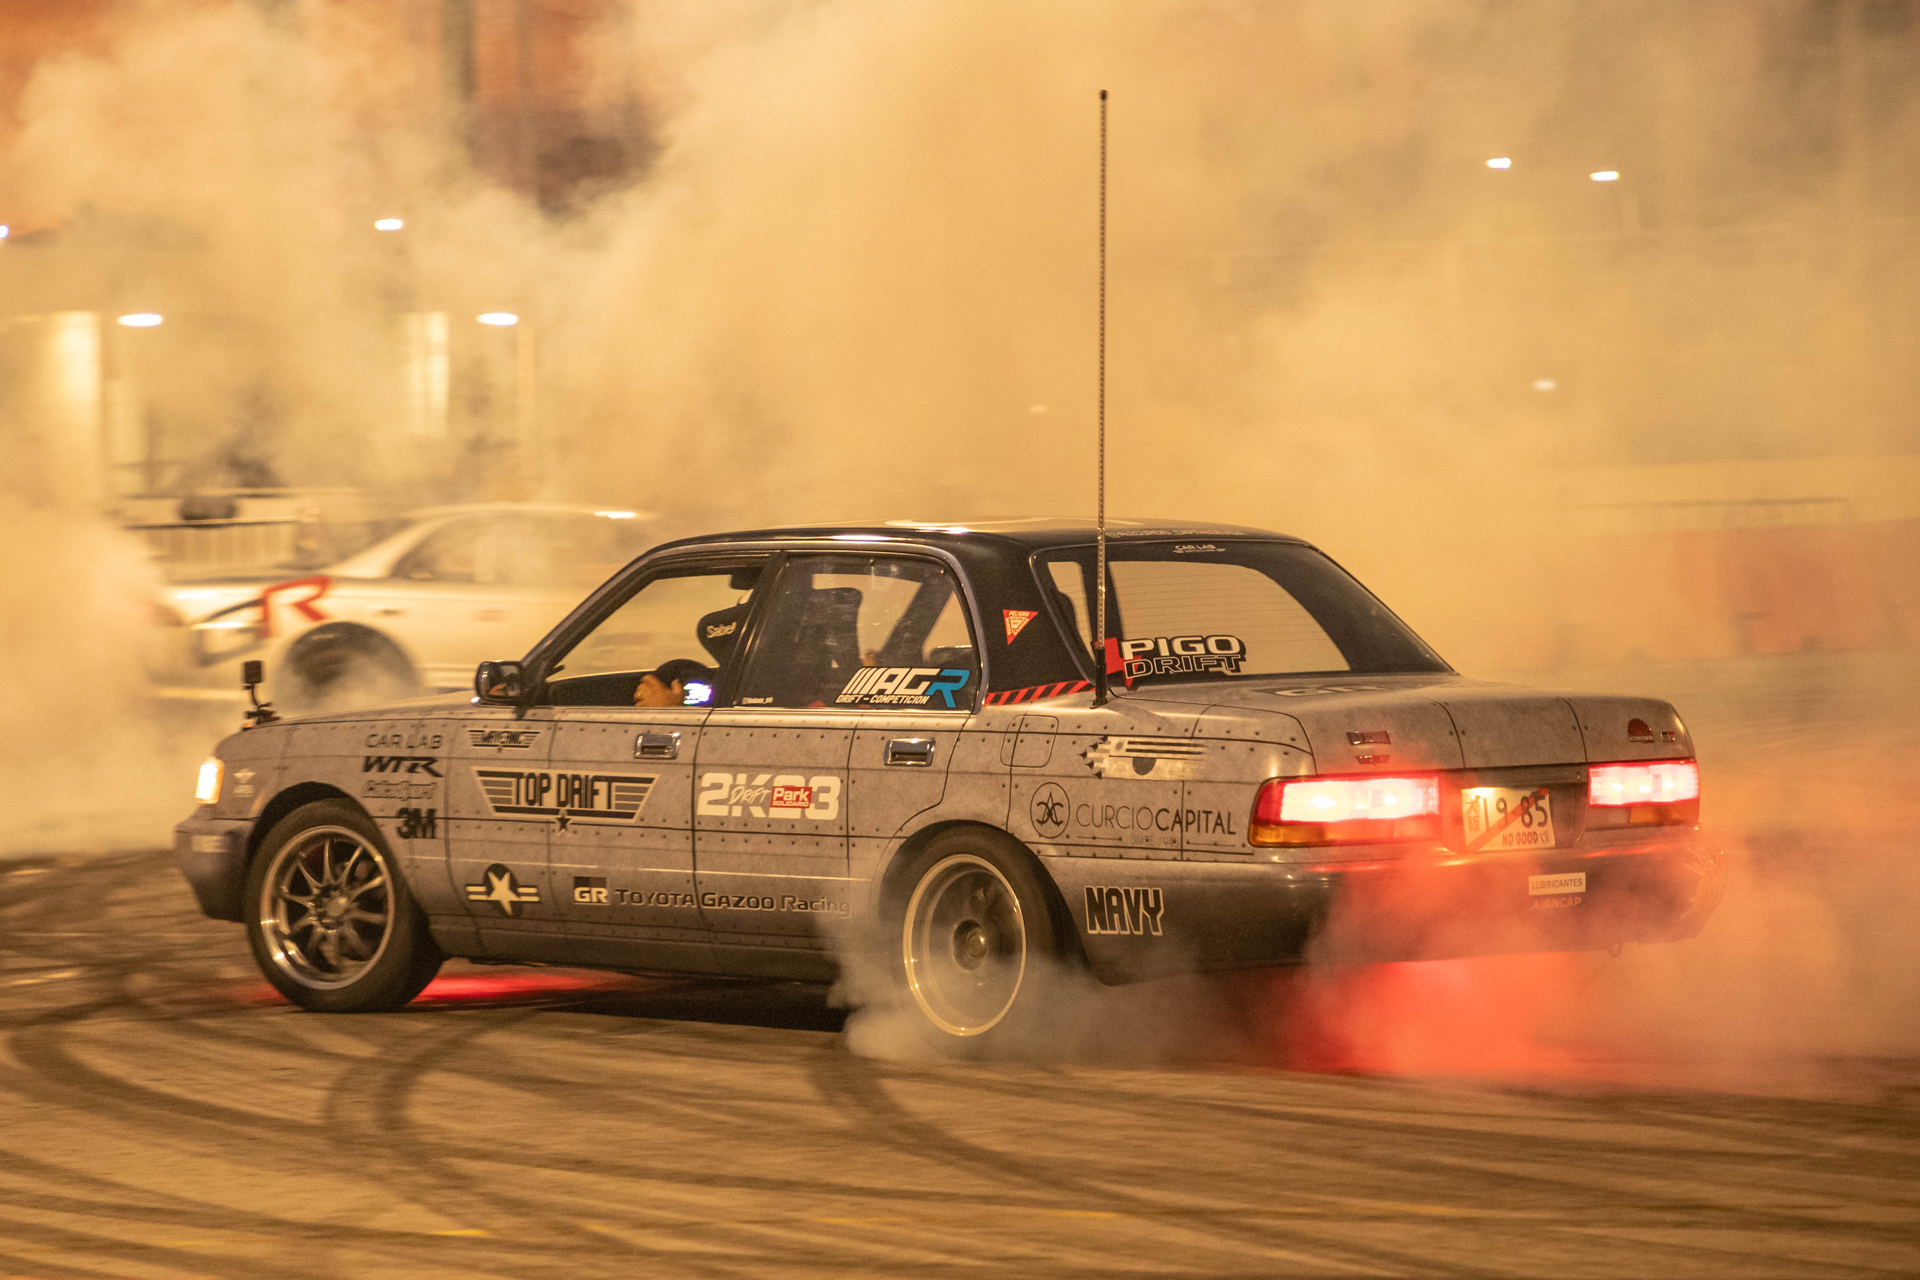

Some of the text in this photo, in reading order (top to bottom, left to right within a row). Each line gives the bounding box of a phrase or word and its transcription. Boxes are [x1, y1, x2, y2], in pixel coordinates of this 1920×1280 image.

[1121, 635, 1246, 661] PIGO
[1124, 655, 1241, 680] DRIFT
[835, 694, 863, 704] DRIFT
[869, 695, 930, 705] COMPETICION
[365, 733, 443, 749] CAR LAB
[512, 772, 616, 810] TOP DRIFT
[728, 785, 810, 805] DRIFT Park
[396, 806, 437, 840] 3M
[1502, 831, 1538, 846] NO GOOD
[1531, 878, 1583, 890] LUBRICANTES
[574, 886, 851, 918] GR TOYOTA GAZOO Racing
[1084, 885, 1164, 936] NAVY
